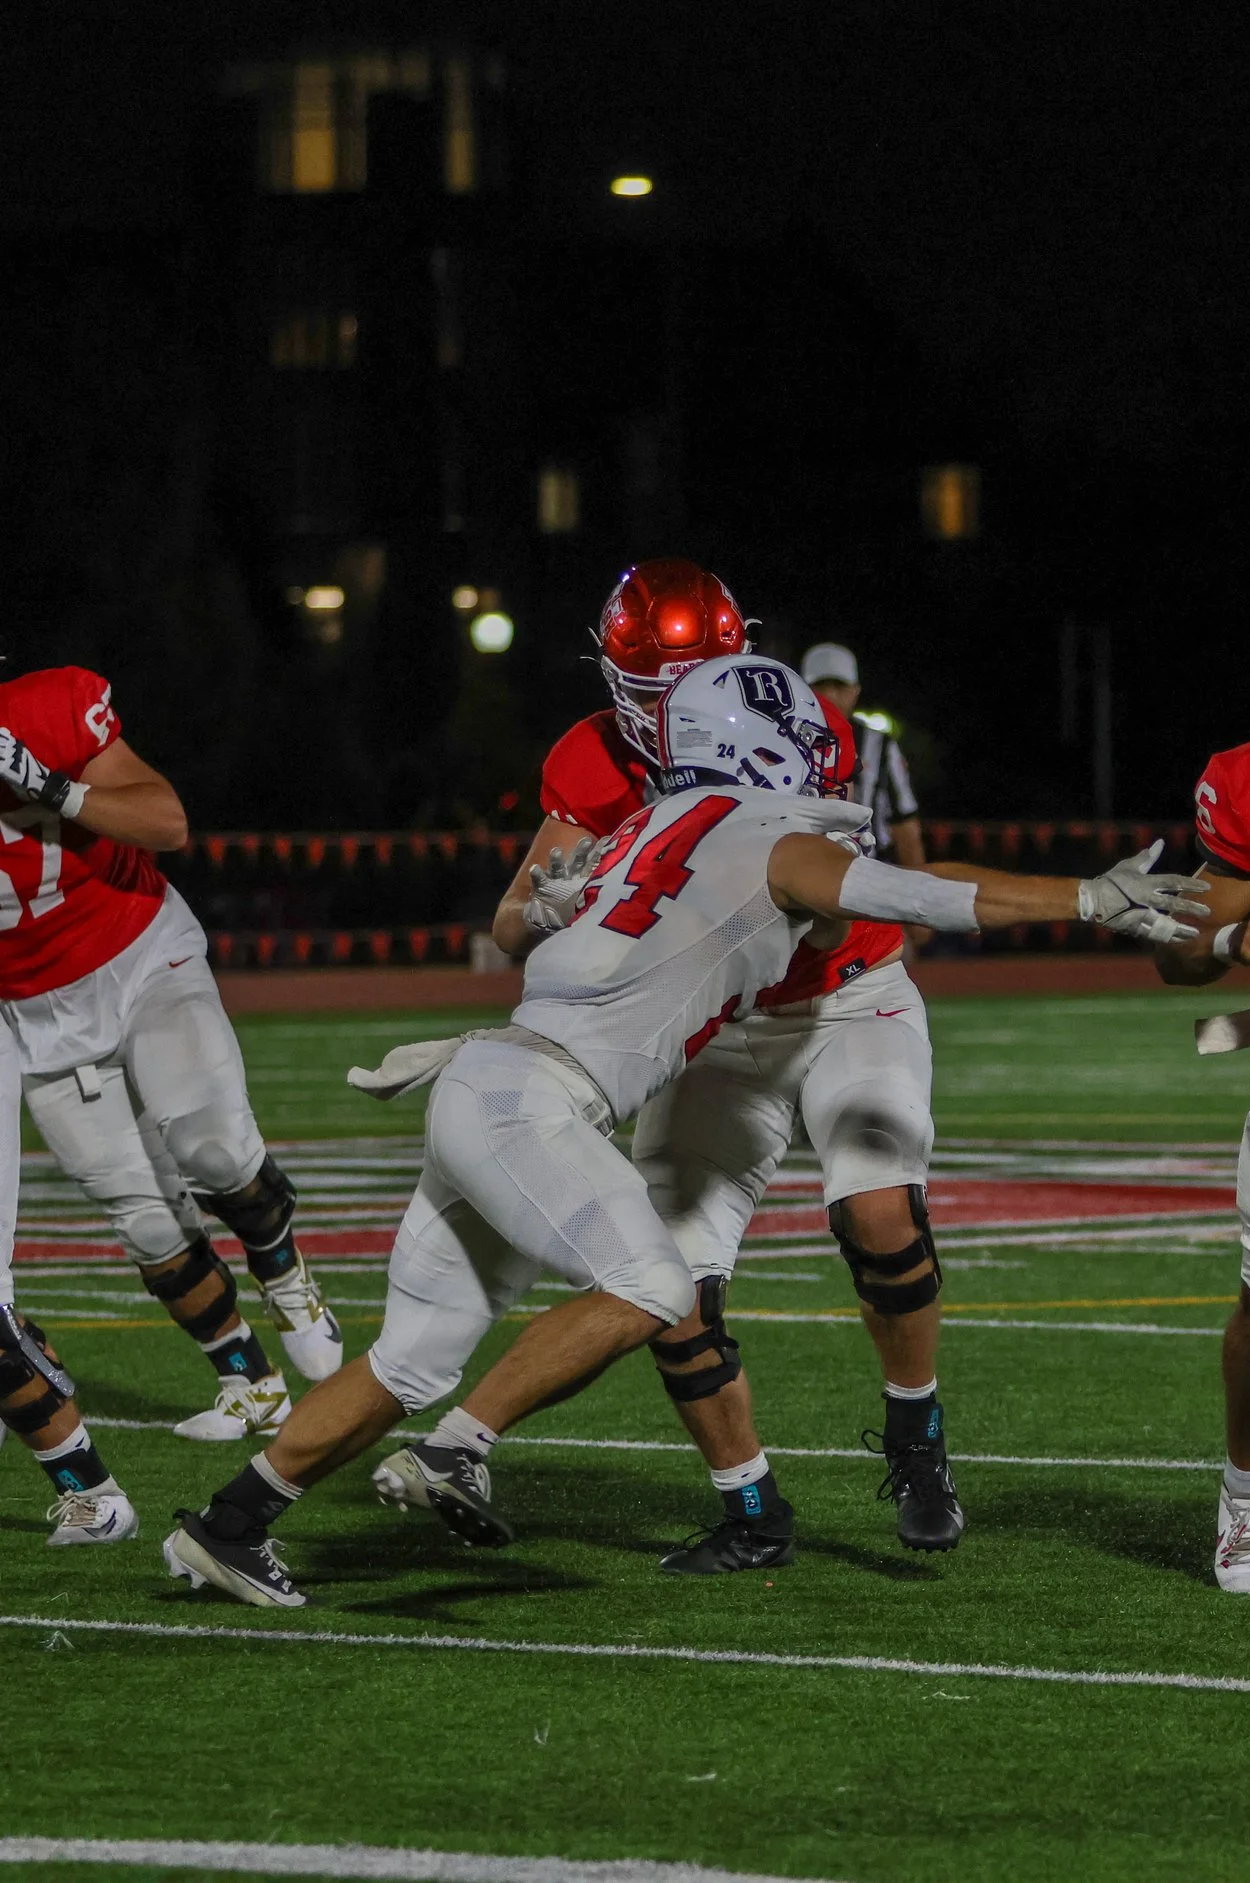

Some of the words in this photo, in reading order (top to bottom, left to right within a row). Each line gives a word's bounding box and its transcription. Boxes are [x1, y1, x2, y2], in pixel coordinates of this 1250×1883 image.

[746, 670, 788, 707] R
[717, 743, 736, 759] 24
[1195, 781, 1217, 834] 6
[845, 964, 861, 976] XL
